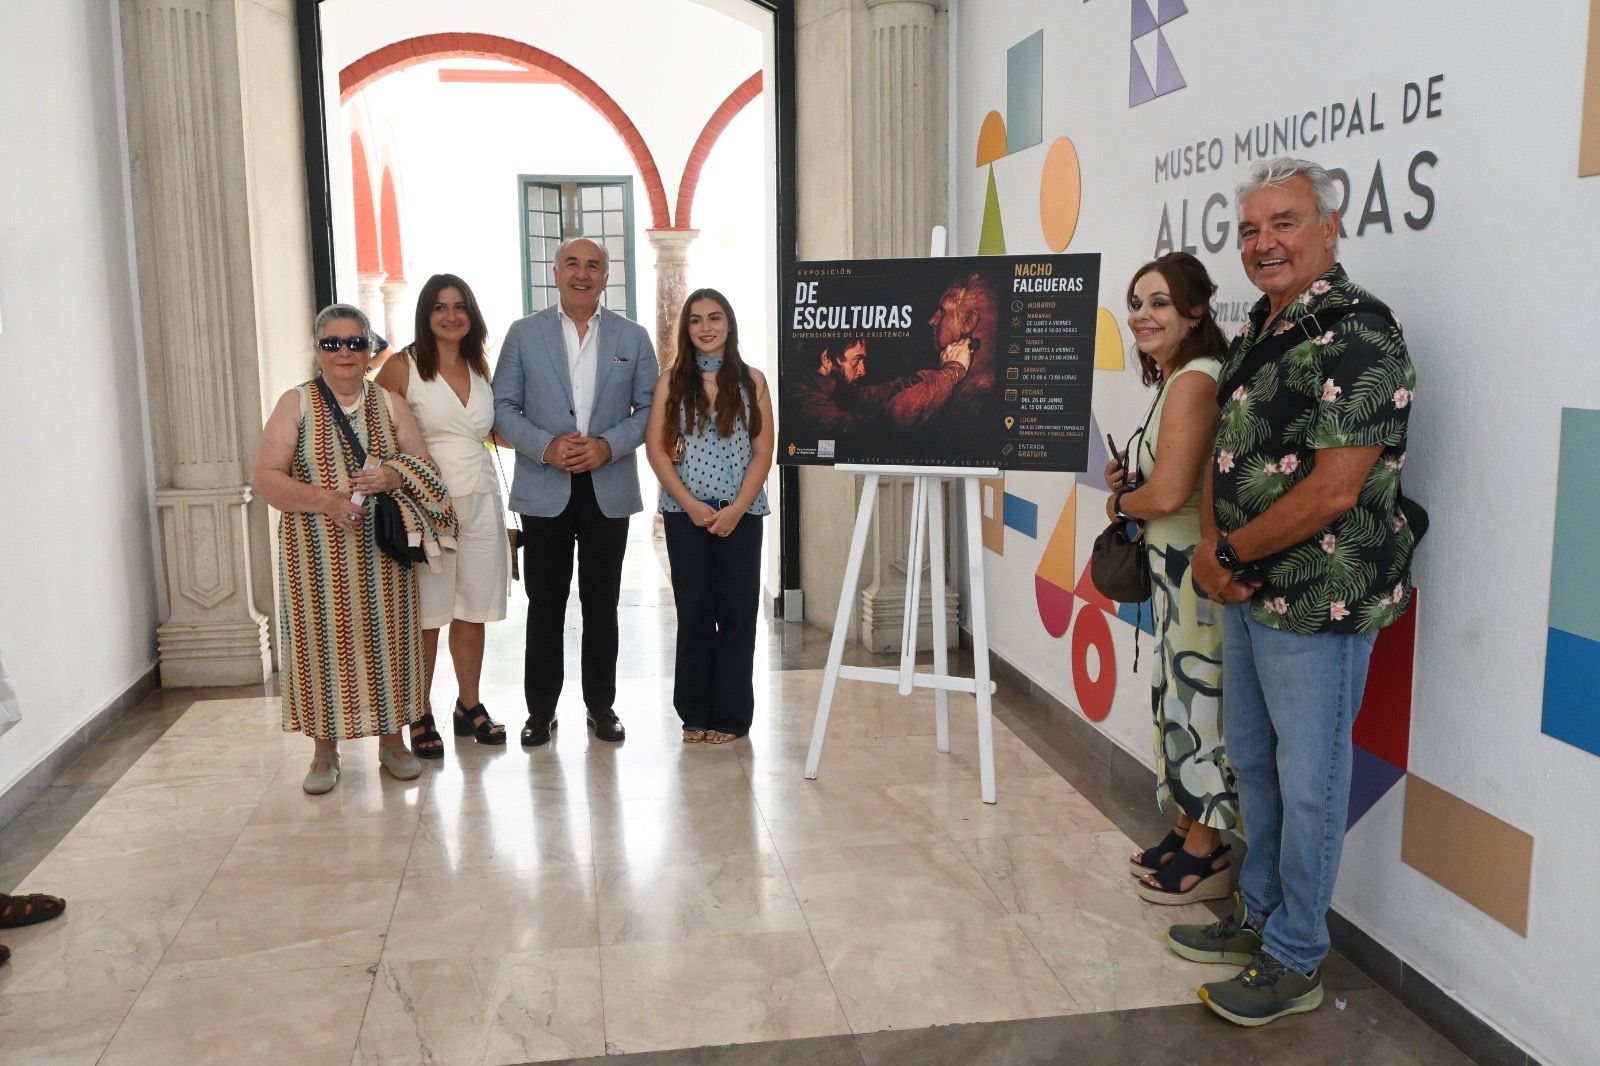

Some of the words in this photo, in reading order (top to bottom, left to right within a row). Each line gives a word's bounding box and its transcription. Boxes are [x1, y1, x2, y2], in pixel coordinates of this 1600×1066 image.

[1155, 137, 1223, 183] MUSEO
[1234, 92, 1384, 164] MUNICIPAL
[1402, 73, 1444, 124] DE
[798, 268, 852, 276] EXPOSICIÓN
[1014, 263, 1053, 277] NACHO
[1013, 277, 1083, 292] FALGUERAS
[795, 281, 819, 304] DE
[1027, 301, 1056, 309] HORARIO
[793, 304, 913, 330] ESCULTURAS
